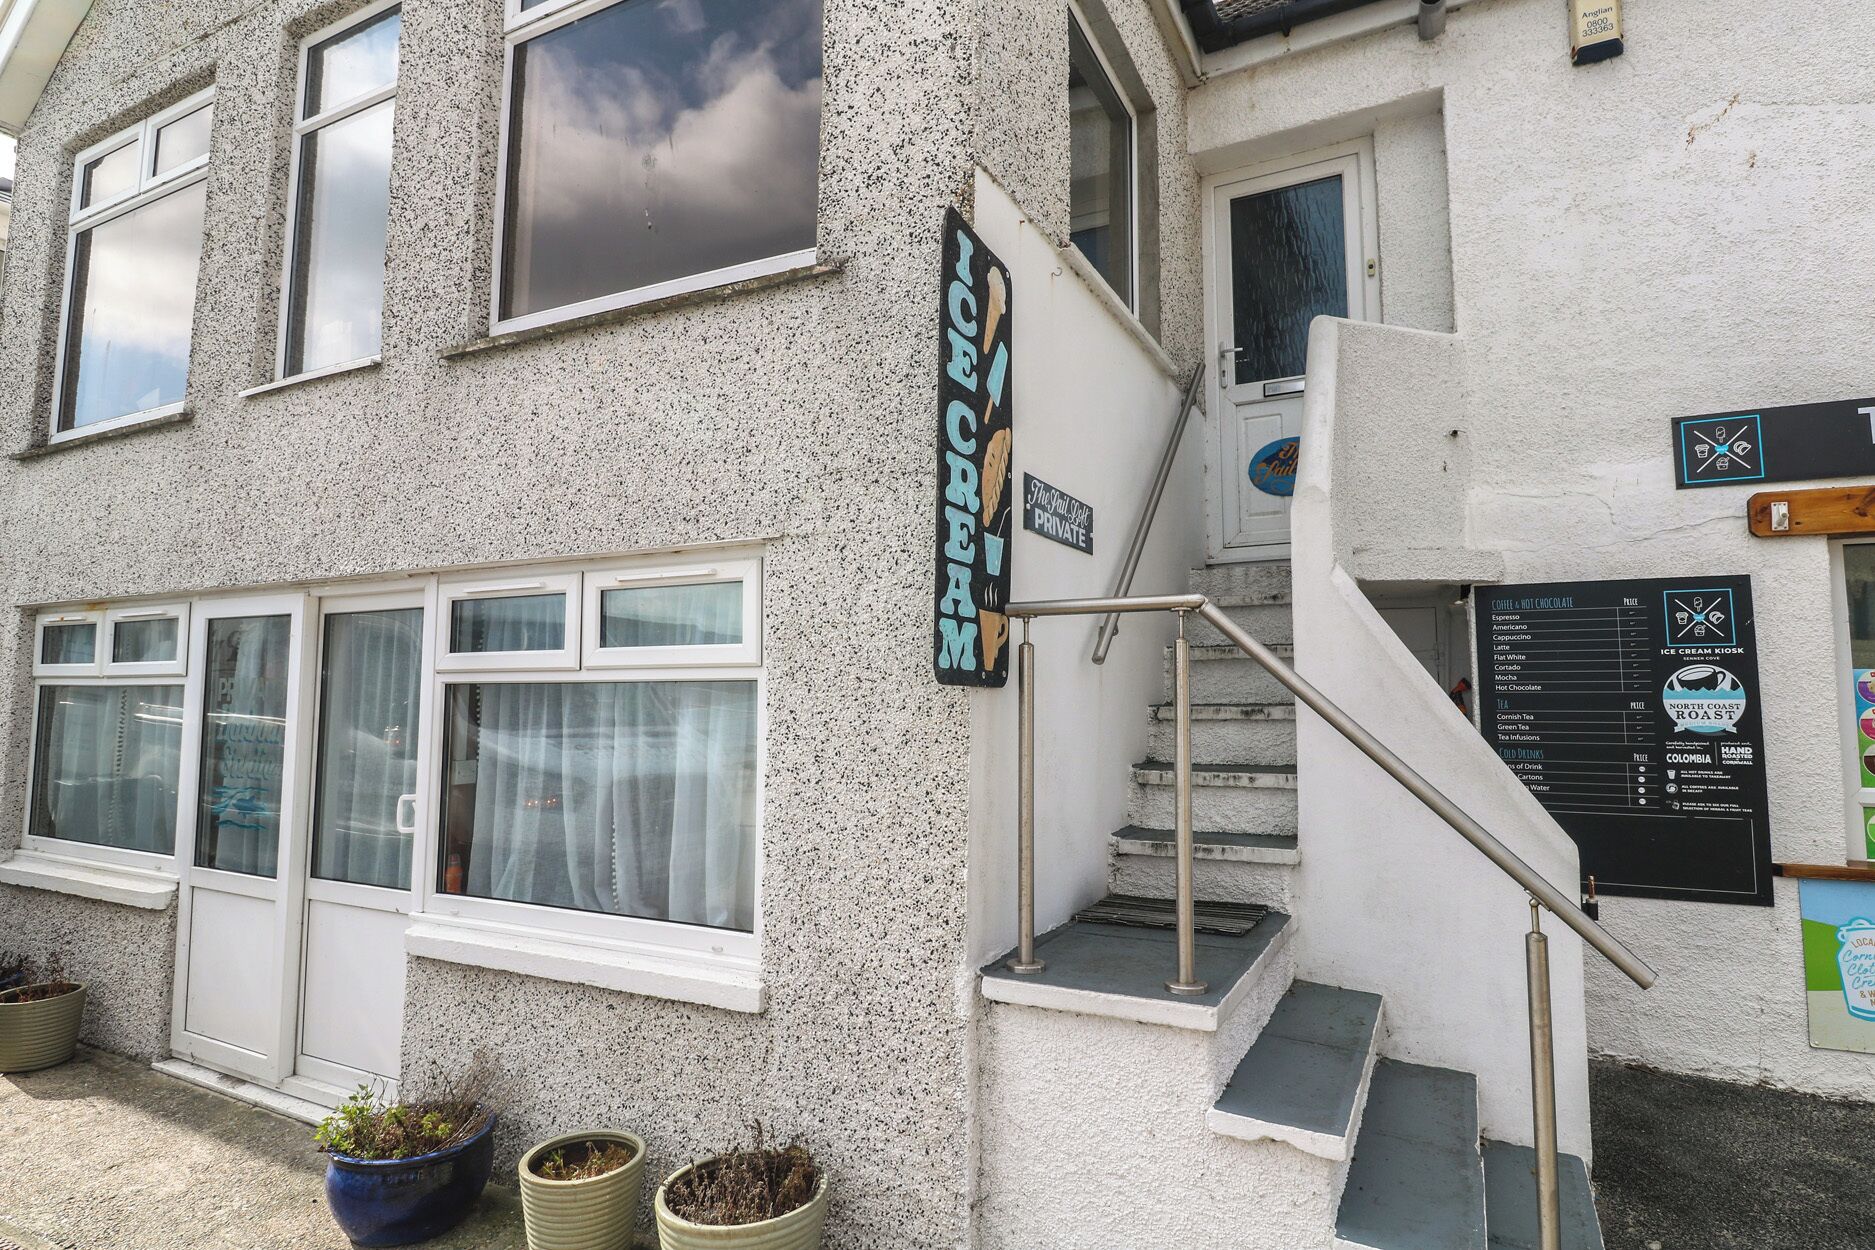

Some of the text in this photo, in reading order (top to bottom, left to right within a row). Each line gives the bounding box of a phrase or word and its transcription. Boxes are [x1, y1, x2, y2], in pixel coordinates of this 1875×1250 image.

[1582, 7, 1612, 19] Anglian
[1586, 17, 1608, 28] 0800
[1582, 23, 1614, 37] 333363
[938, 230, 980, 671] ICE CREAM
[1028, 479, 1050, 508] The
[1034, 508, 1086, 548] PRIVATE
[1492, 600, 1513, 610] COFFEE
[1521, 598, 1534, 610] HOT
[1536, 596, 1574, 608] CHOCOLATE
[1497, 698, 1508, 710] TEA
[1676, 710, 1735, 720] ROAST
[1518, 748, 1544, 759] DRINKS
[1666, 754, 1712, 764] COLOMBIA
[1851, 938, 1875, 948] LOCA
[1843, 950, 1875, 962] Corn
[1847, 962, 1875, 976] Clot
[1852, 976, 1875, 989] Cre
